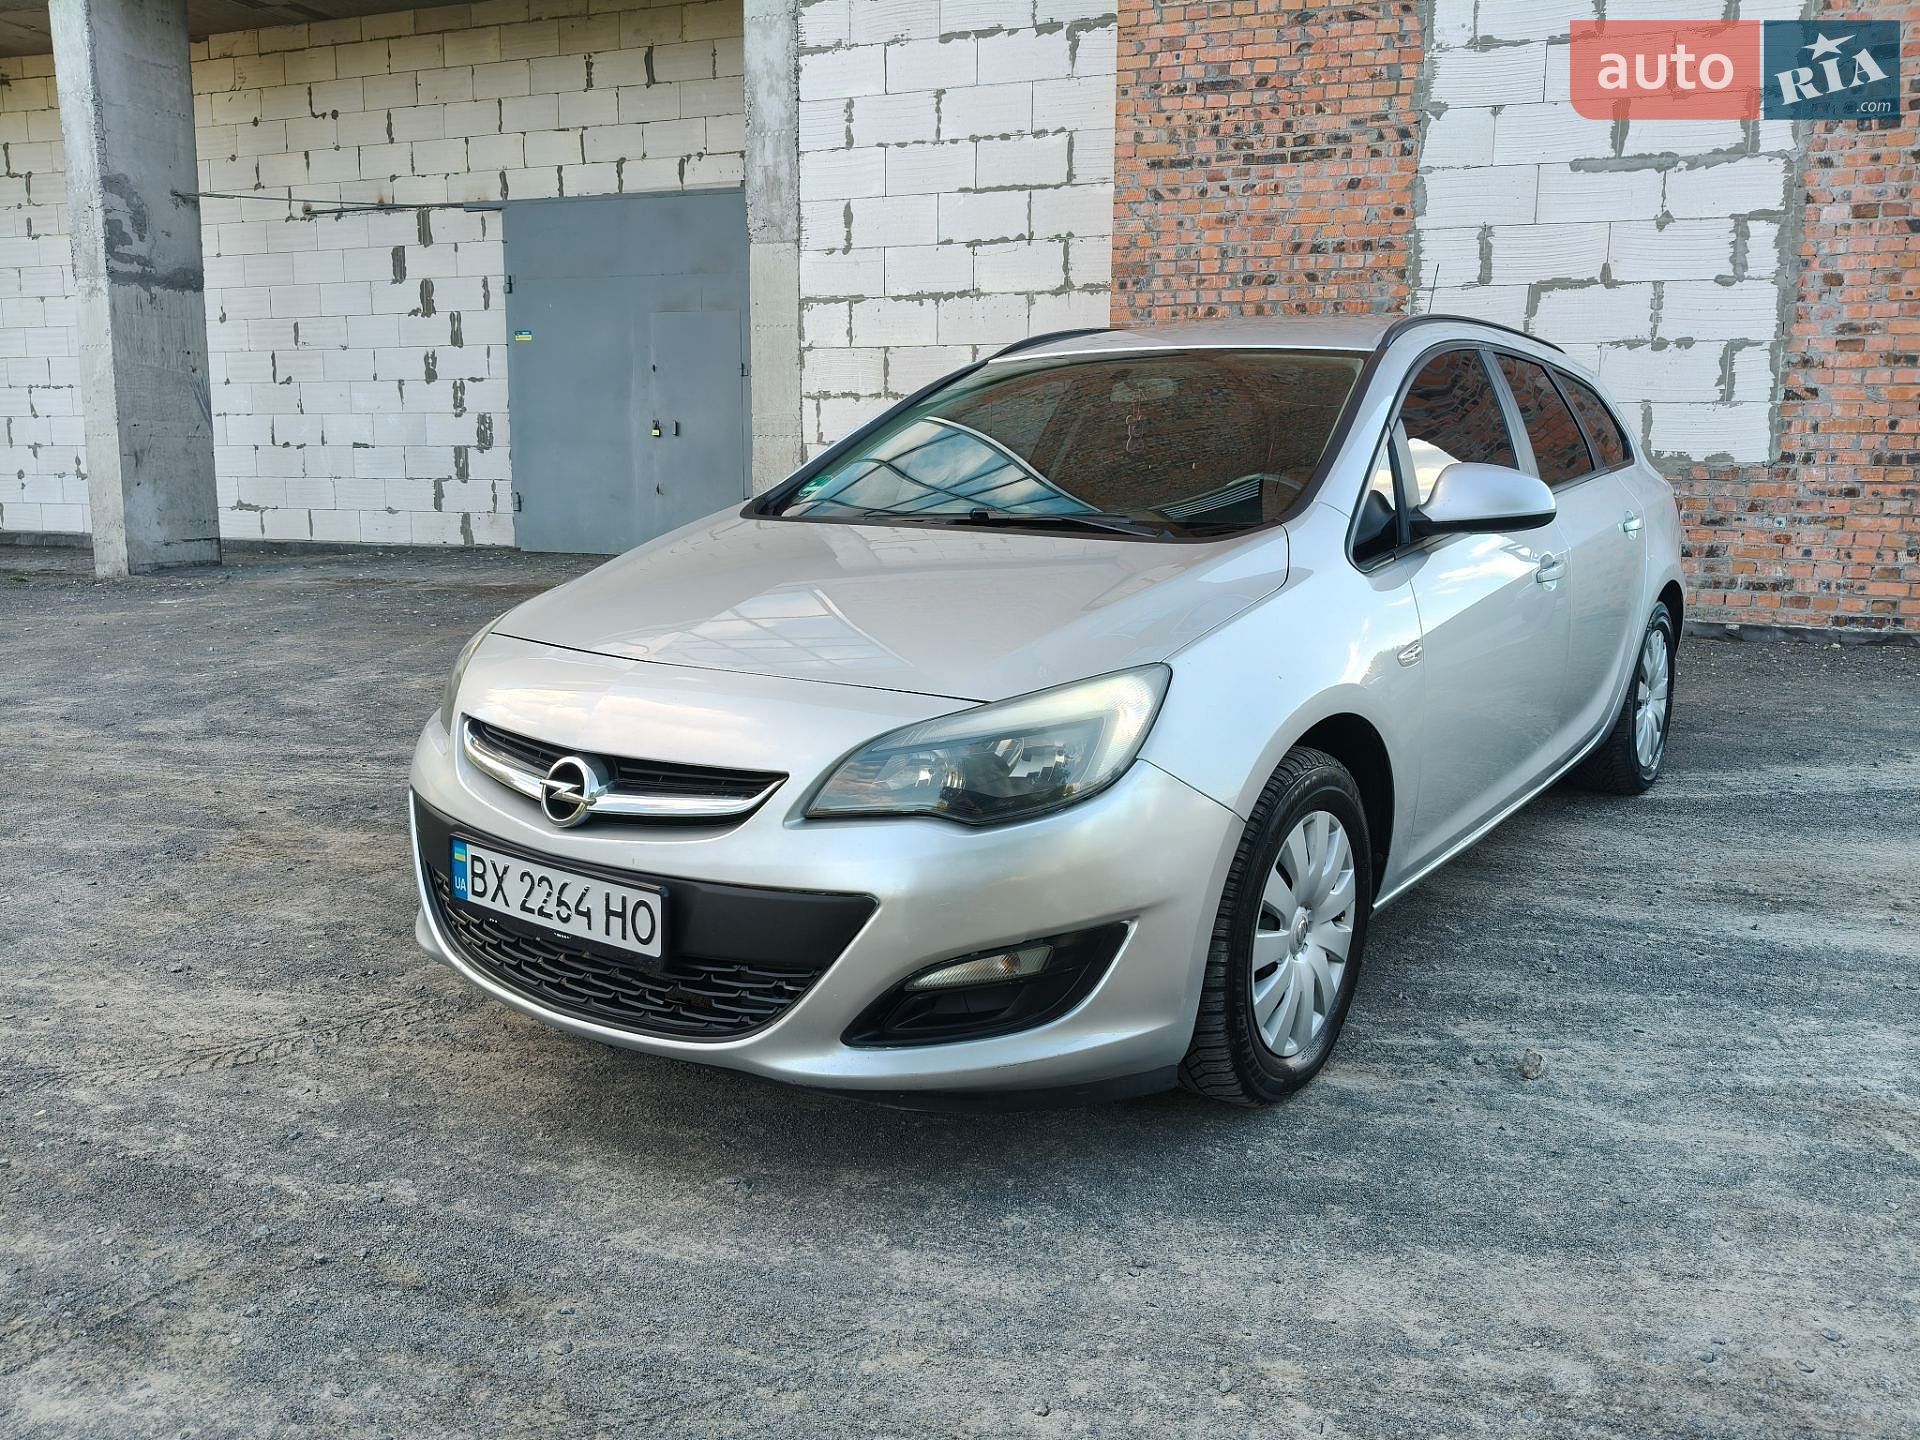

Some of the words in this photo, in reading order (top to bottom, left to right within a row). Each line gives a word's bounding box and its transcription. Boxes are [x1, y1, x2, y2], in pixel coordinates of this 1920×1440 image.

[454, 877, 467, 892] UA
[471, 854, 510, 908] BX
[519, 869, 592, 931] 2264
[604, 891, 656, 946] HO
